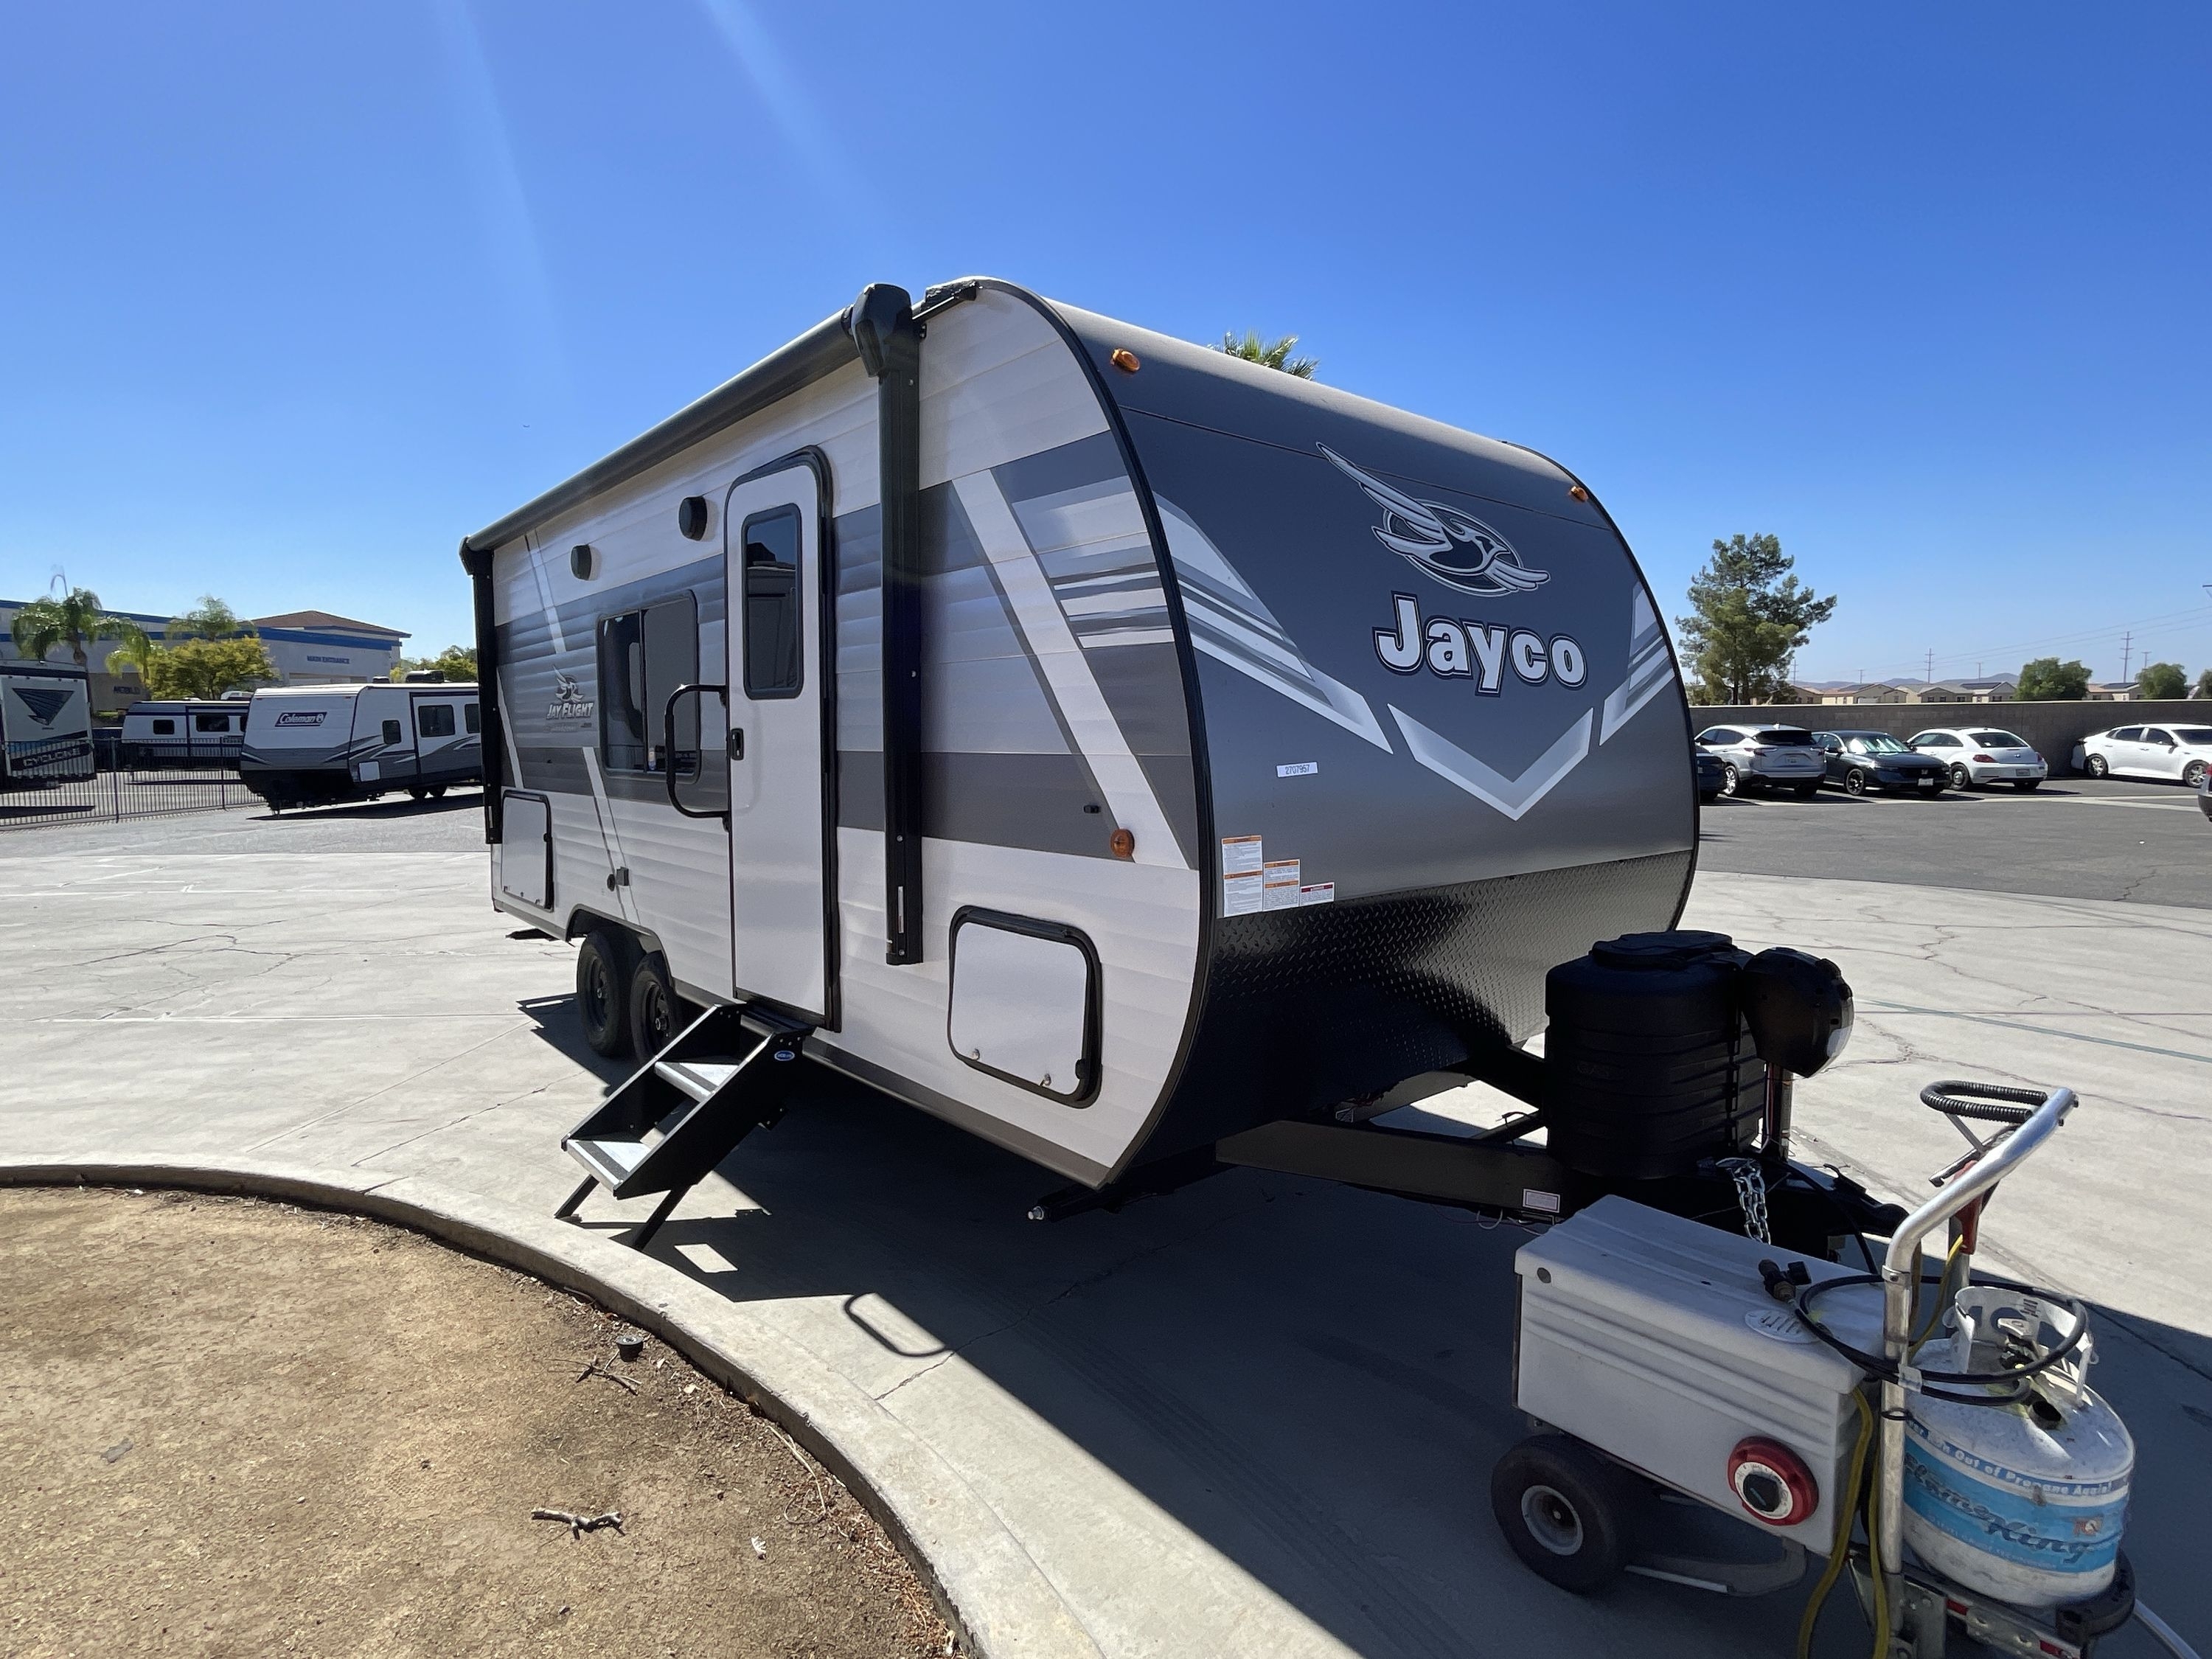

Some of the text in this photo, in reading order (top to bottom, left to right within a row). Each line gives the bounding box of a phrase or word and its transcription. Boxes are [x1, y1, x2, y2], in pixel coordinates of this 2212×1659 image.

[1372, 591, 1587, 697] Jayco
[279, 713, 316, 724] Coleman
[546, 702, 594, 720] JAY FLIGHT
[1955, 1450, 1980, 1468] Out
[1984, 1464, 2002, 1477] of
[2005, 1471, 2069, 1495] Propane
